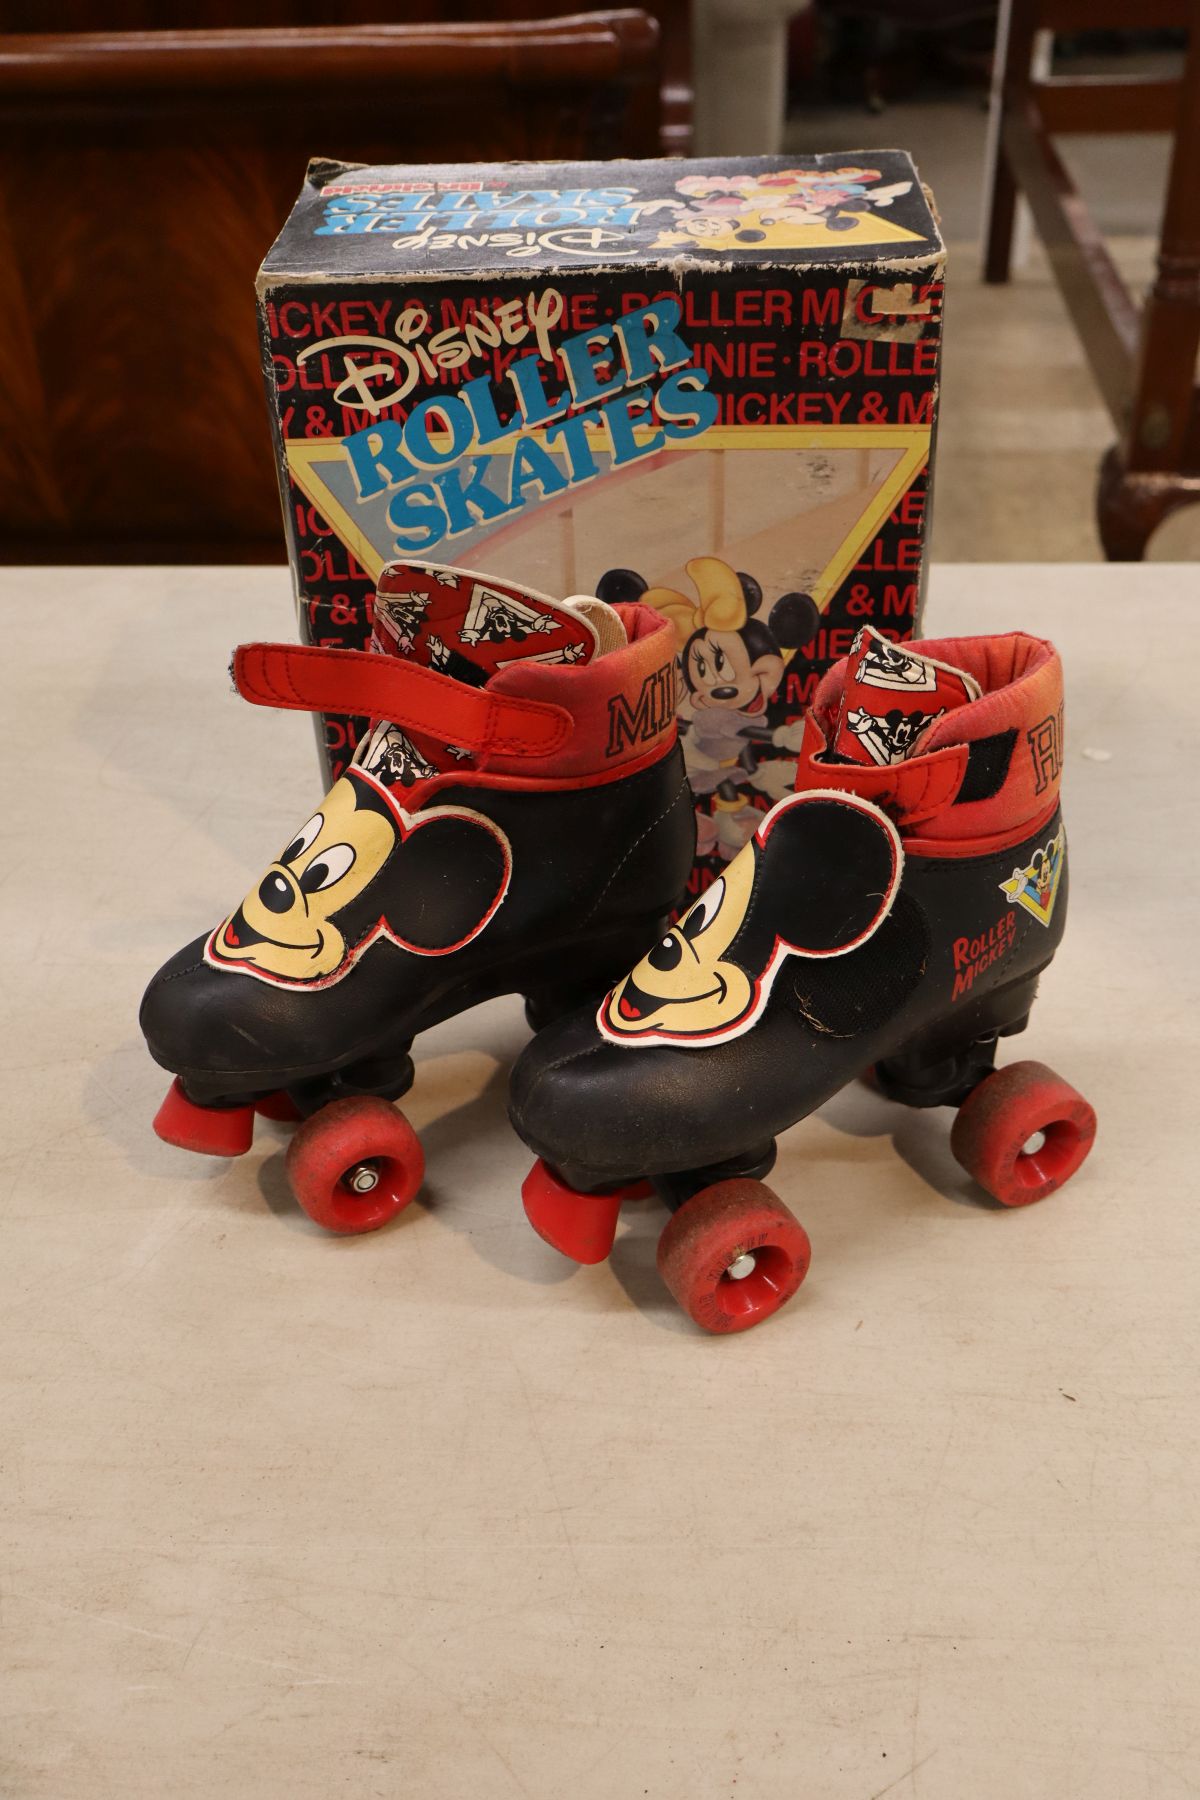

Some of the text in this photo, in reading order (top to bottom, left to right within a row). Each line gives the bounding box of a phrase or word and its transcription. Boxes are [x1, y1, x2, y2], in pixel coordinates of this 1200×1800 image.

[313, 206, 645, 236] ROLLER
[322, 186, 639, 216] SKATES
[440, 293, 599, 335] MIIE
[340, 299, 695, 504] ROLLER
[714, 391, 851, 425] ICKEY
[857, 391, 888, 425] &
[385, 367, 720, 557] SKATES
[605, 656, 677, 758] MI
[951, 926, 1017, 1003] MICKEY
[953, 910, 1016, 971] ROLLER
